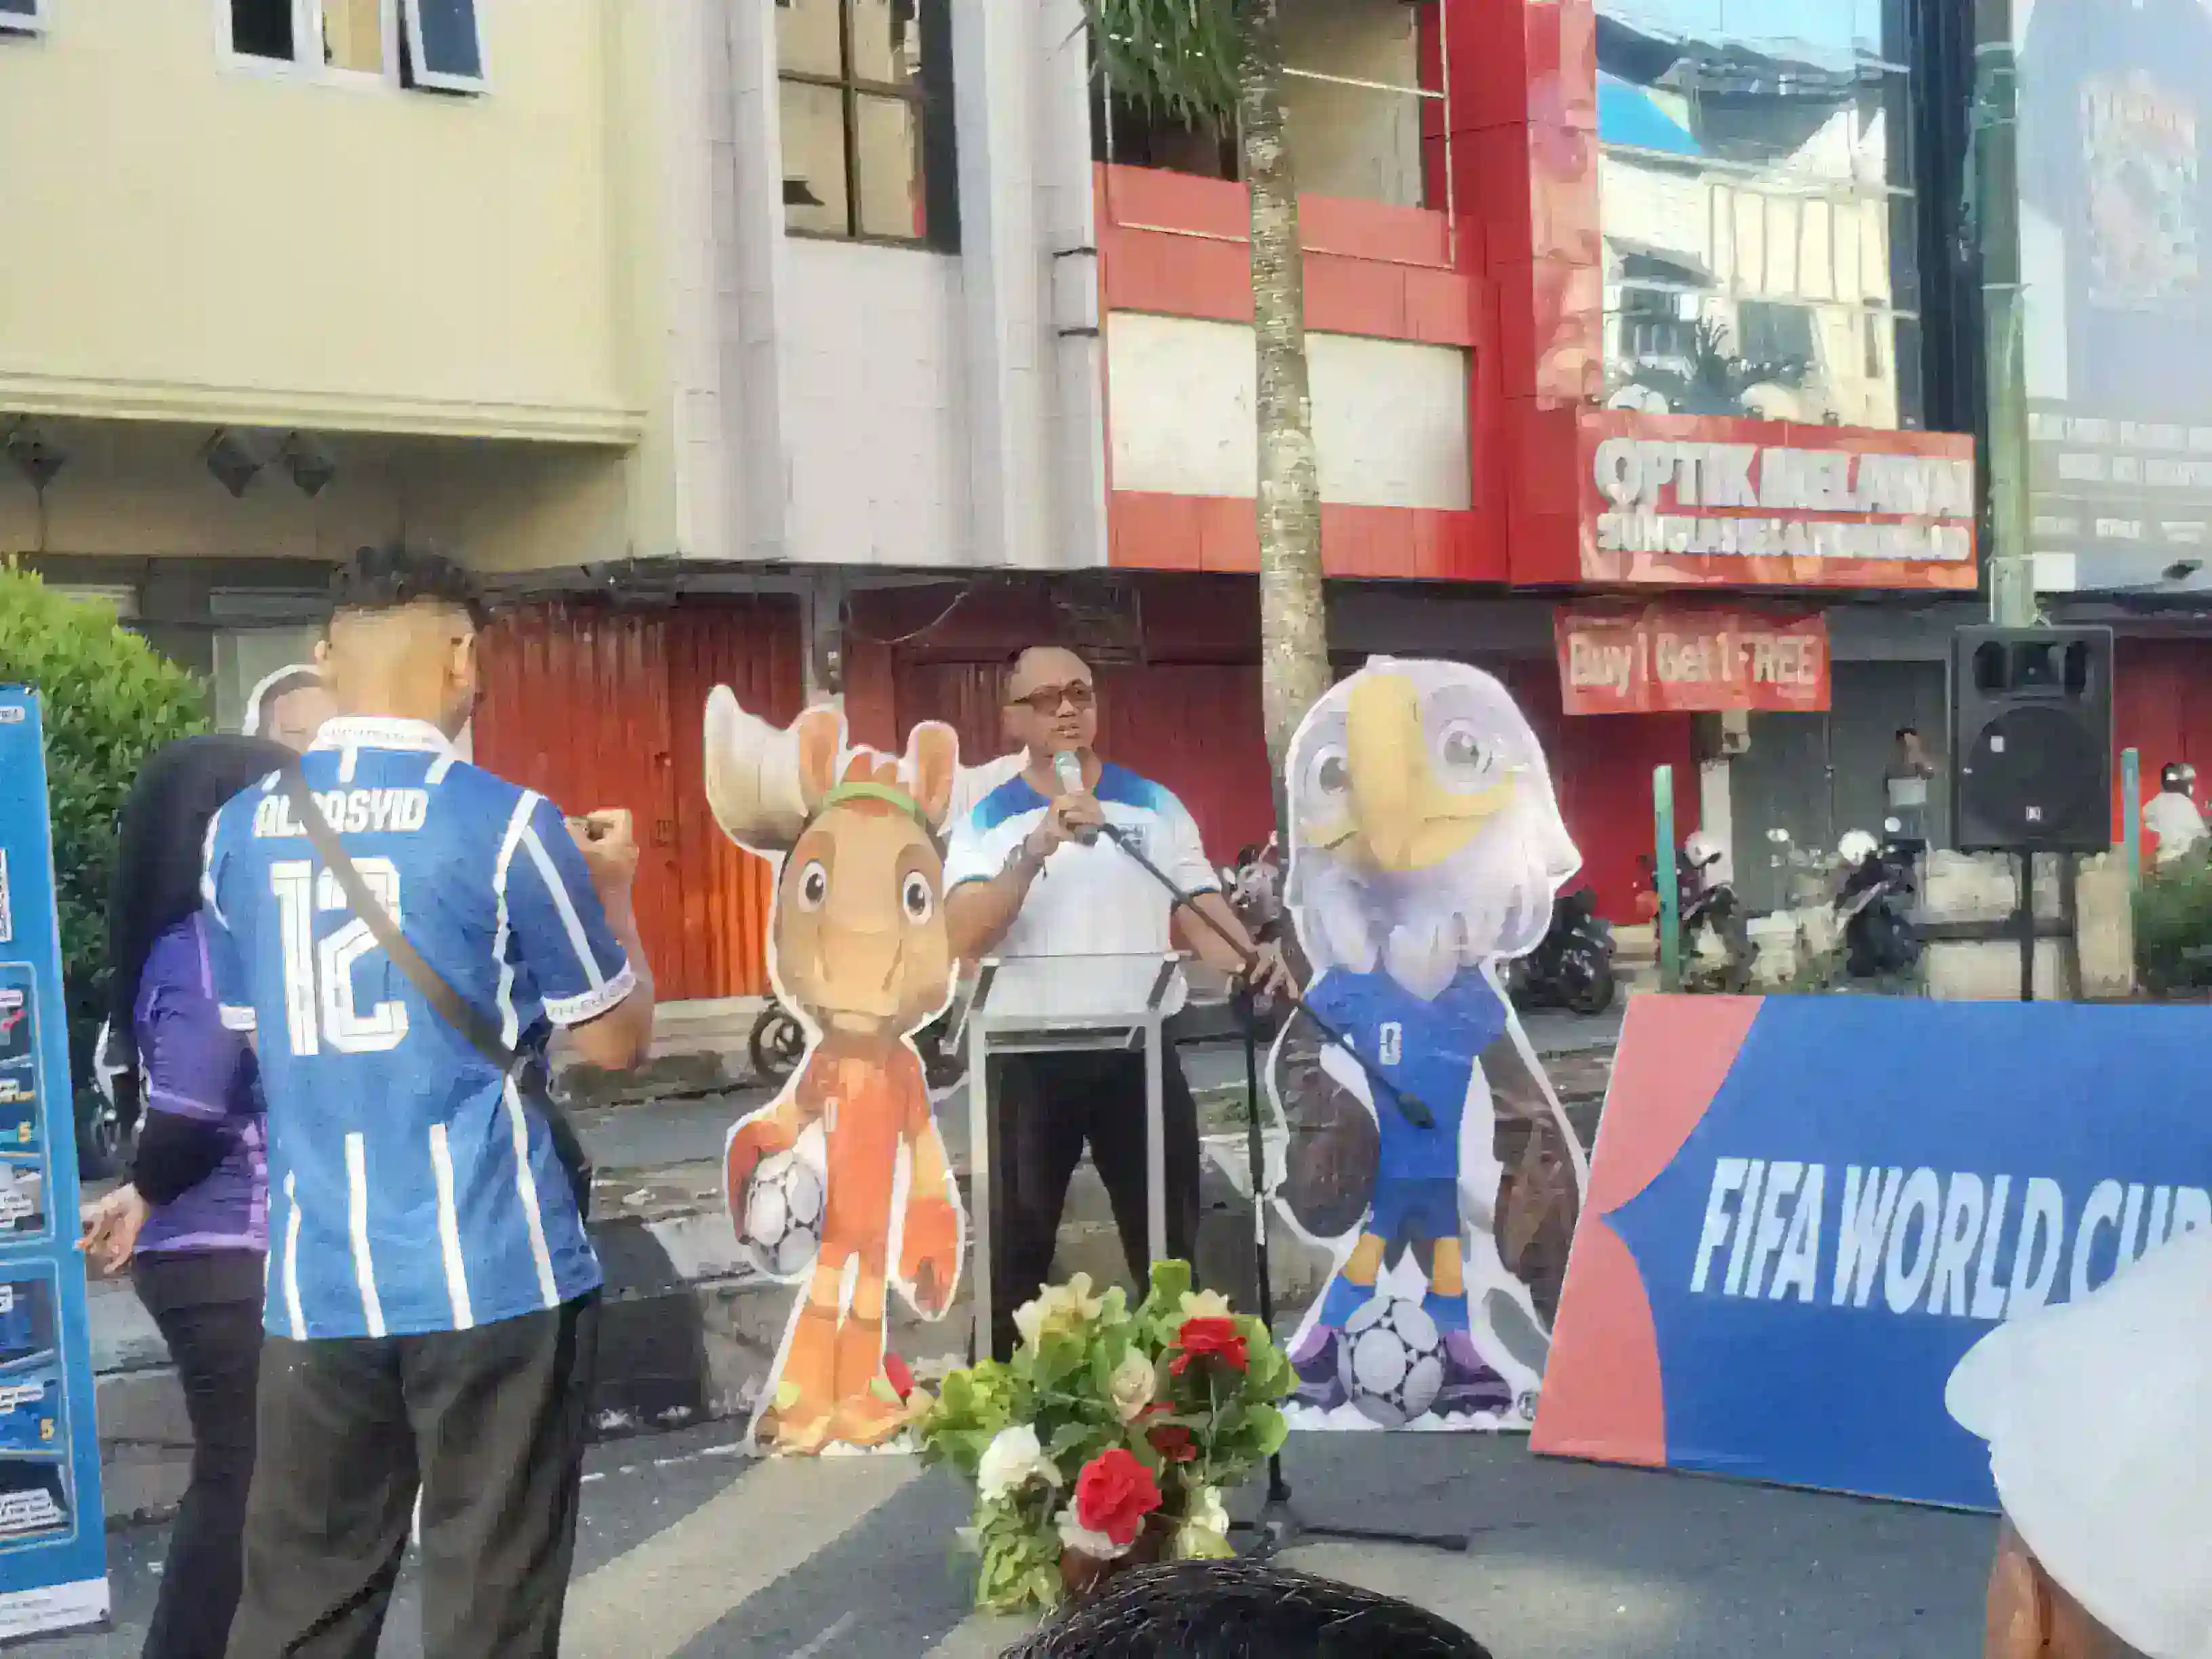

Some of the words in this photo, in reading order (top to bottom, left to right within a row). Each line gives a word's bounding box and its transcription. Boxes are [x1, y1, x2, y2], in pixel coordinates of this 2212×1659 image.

[1594, 437, 1760, 507] OPTIK
[1570, 632, 1631, 697] Buy
[1656, 634, 1712, 681] Get
[268, 856, 409, 1056] 12
[1689, 1156, 1825, 1304] FIFA
[1831, 1164, 2065, 1321] WORLD
